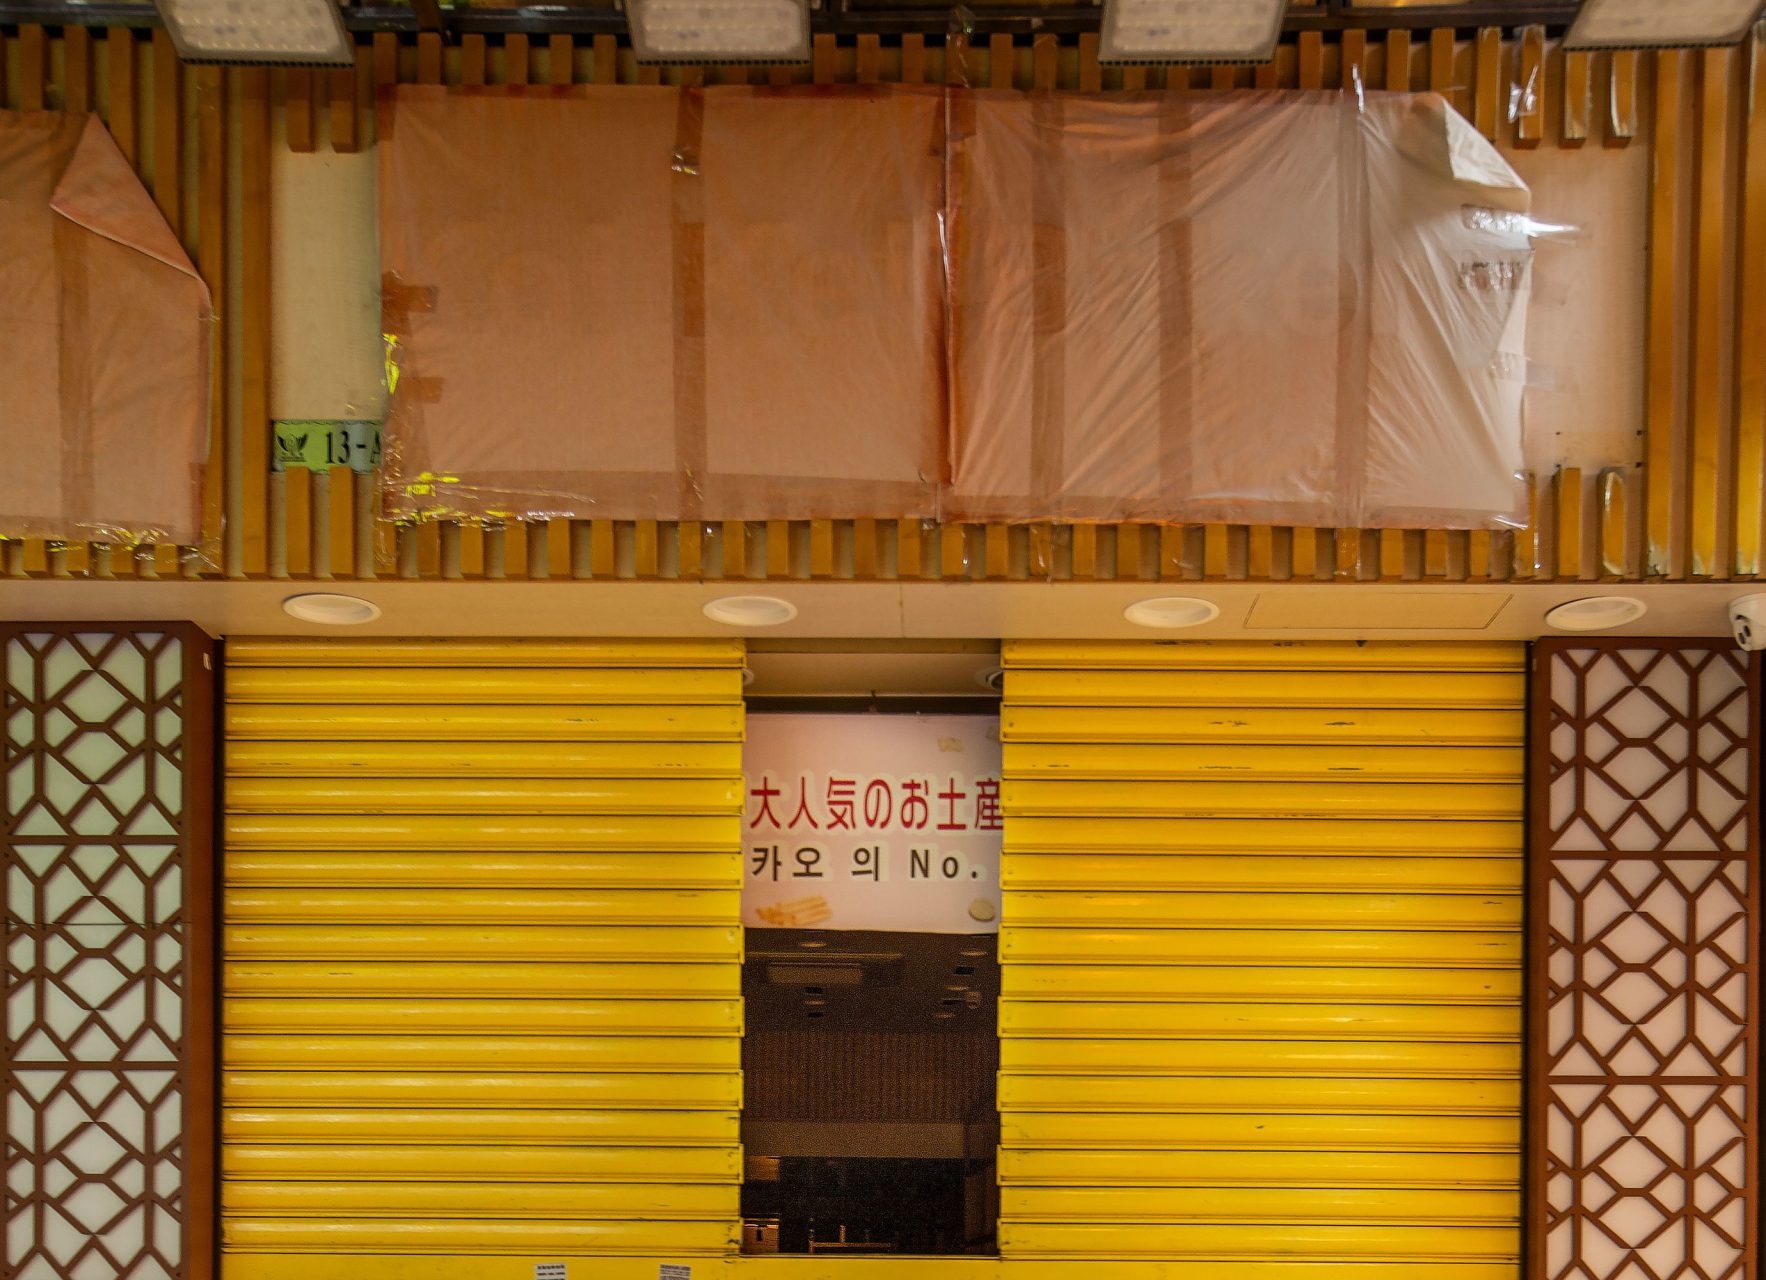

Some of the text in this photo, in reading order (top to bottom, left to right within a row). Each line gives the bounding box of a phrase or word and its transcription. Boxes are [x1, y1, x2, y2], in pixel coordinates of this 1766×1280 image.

[750, 776, 1003, 830] 大人気のお土産
[910, 849, 980, 879] No.
